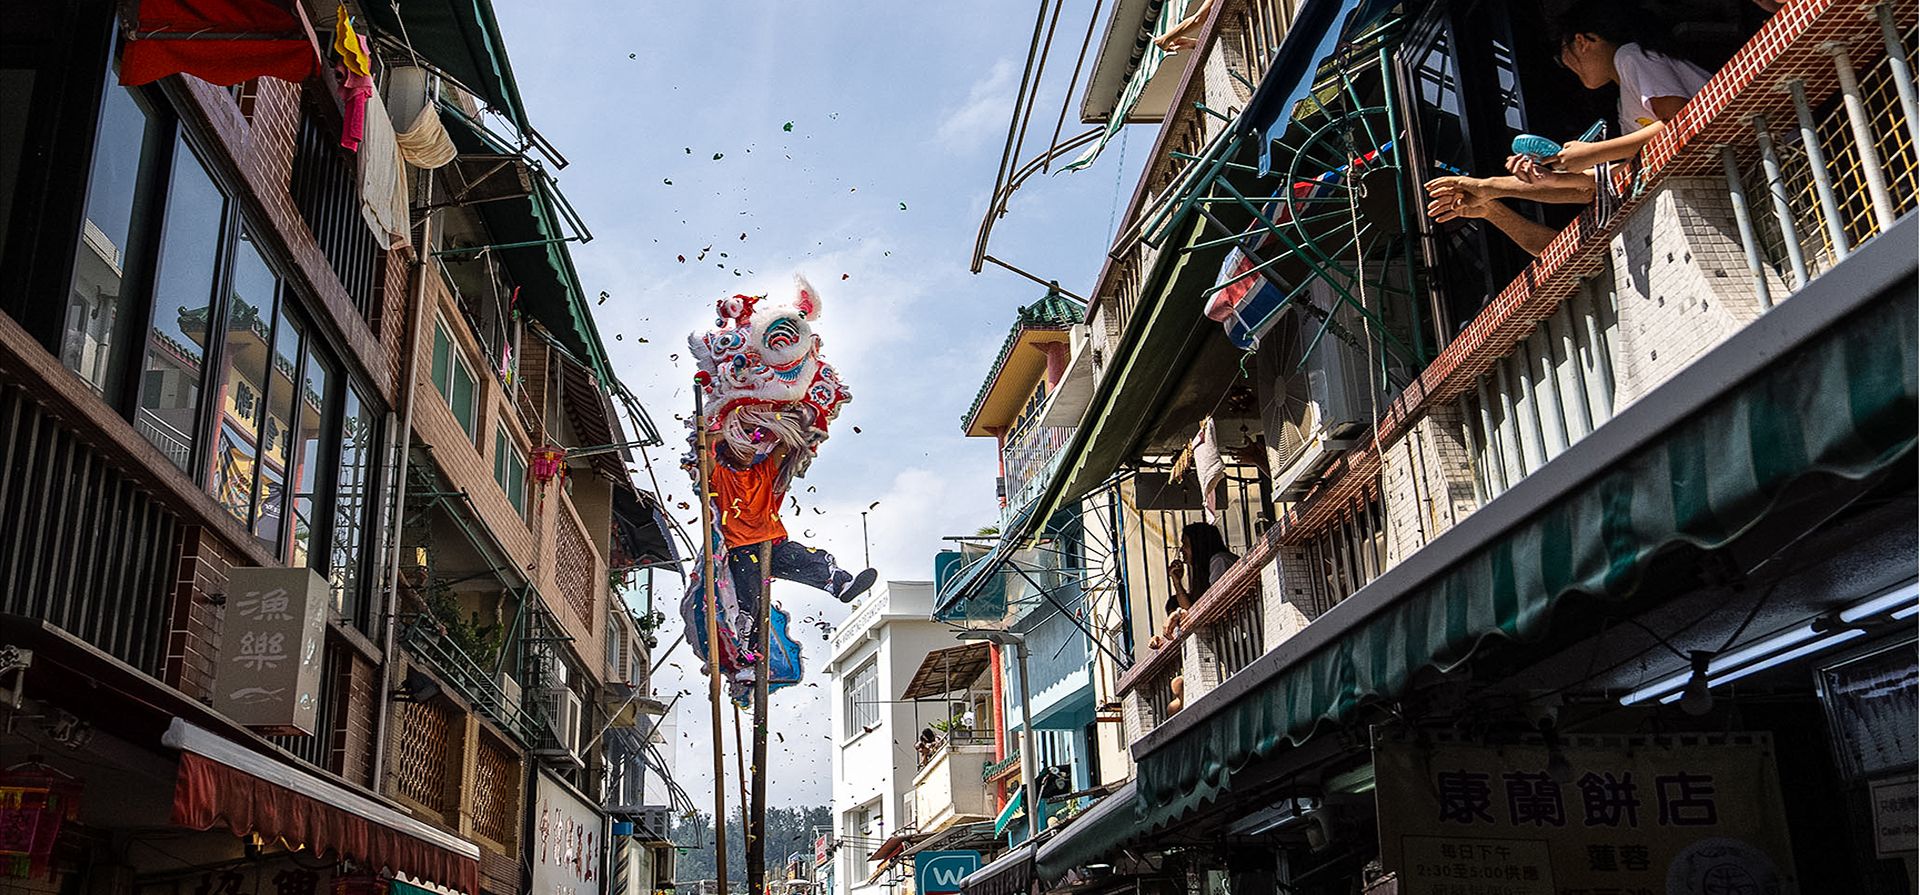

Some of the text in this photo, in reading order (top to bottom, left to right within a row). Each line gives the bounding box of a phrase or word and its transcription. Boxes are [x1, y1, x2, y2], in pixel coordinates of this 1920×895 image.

[232, 587, 294, 671] 漁樂
[1437, 769, 1717, 827] 康蘭餅店
[1440, 844, 1511, 861] 每日下午
[1587, 844, 1651, 872] 蓮蓉
[932, 866, 965, 886] W
